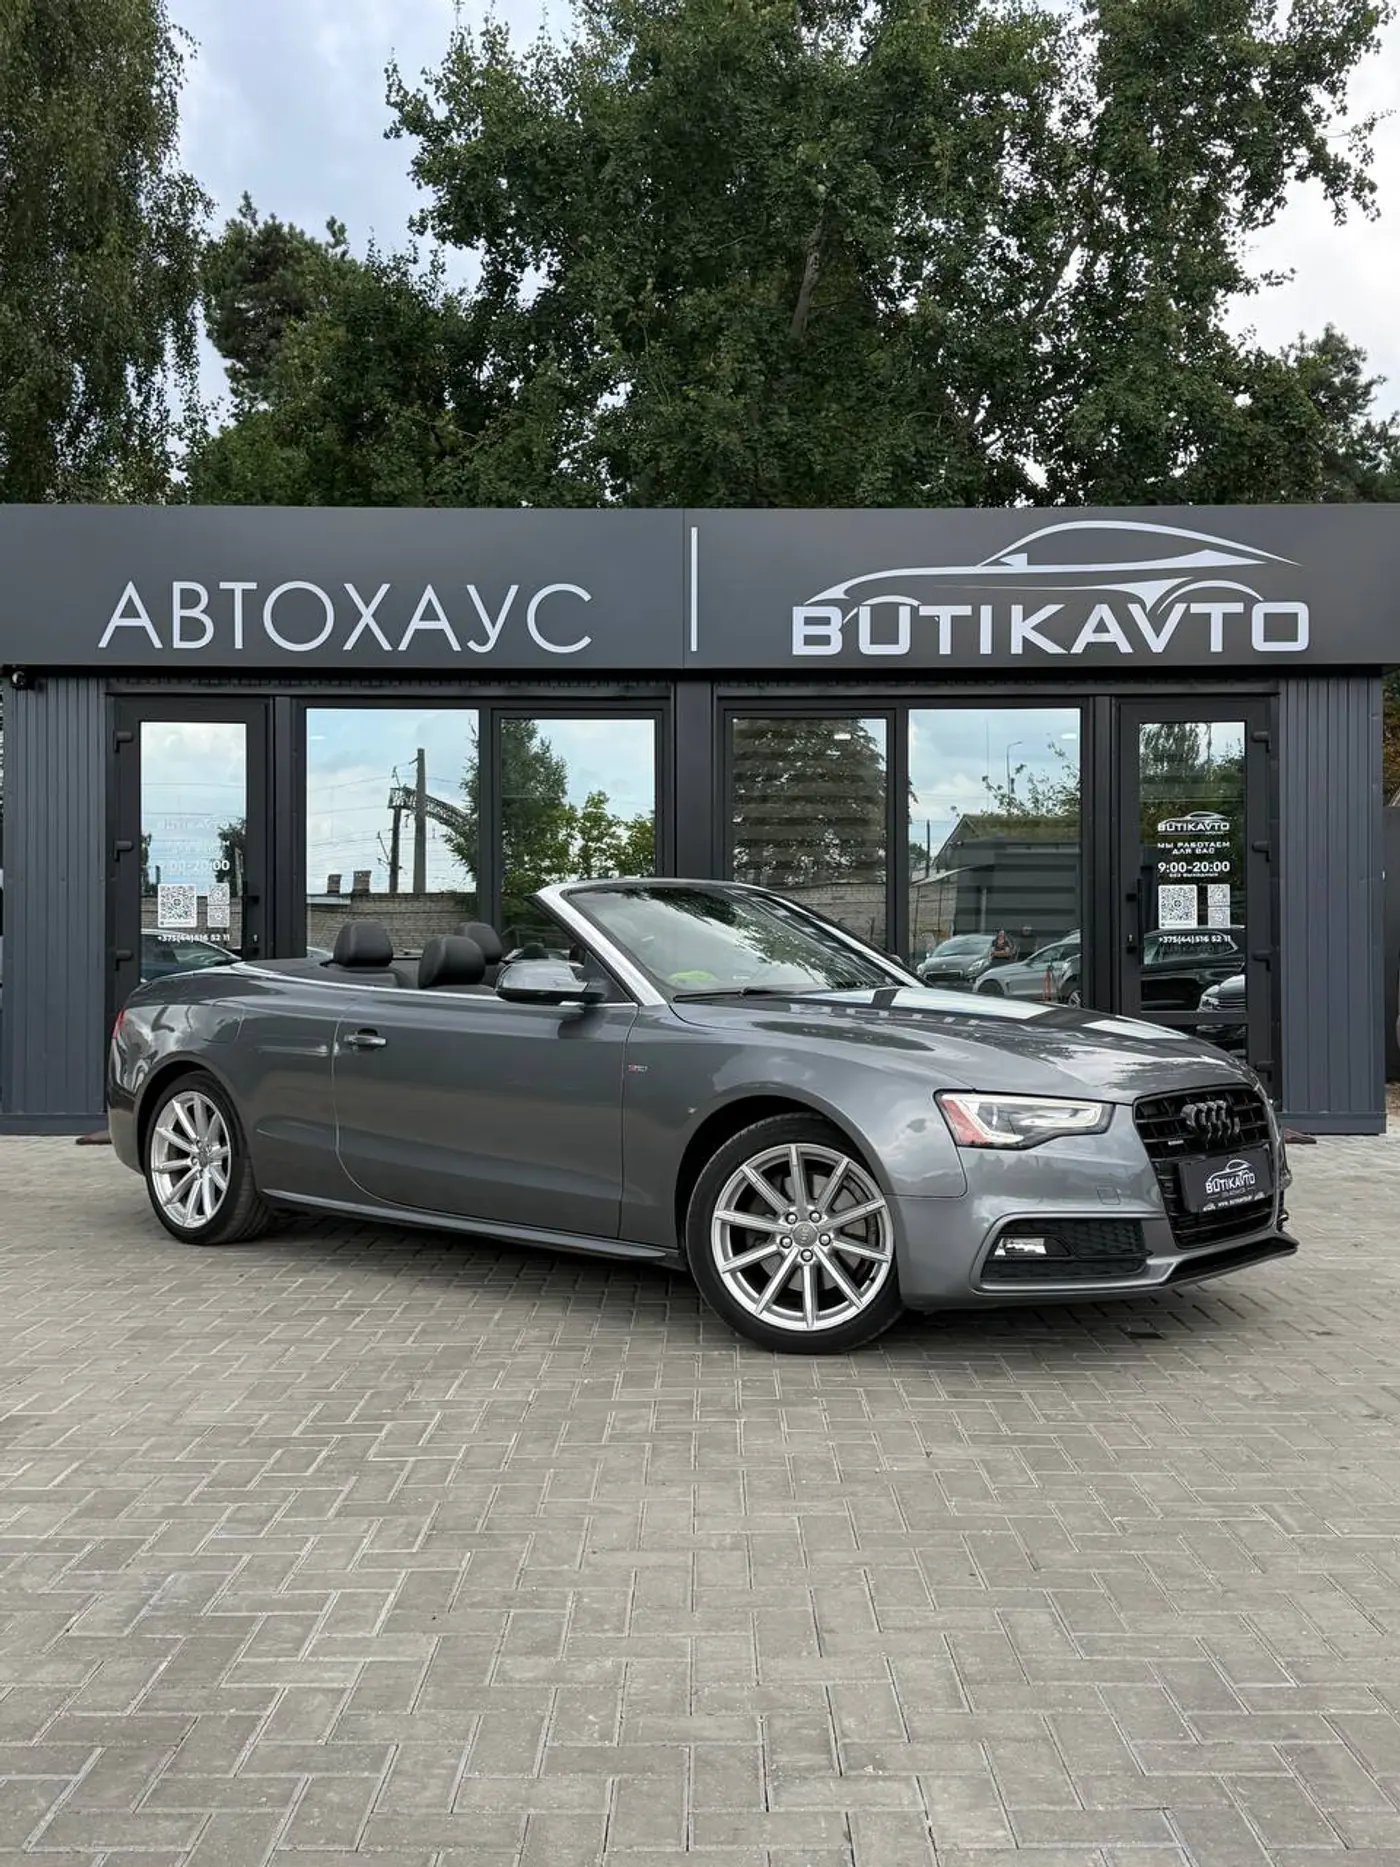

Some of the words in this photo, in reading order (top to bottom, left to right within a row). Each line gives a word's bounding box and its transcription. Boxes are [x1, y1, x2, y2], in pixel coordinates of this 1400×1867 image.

[98, 580, 593, 655] АВТОХАУС
[791, 601, 1310, 656] BUTIKAVTO
[1157, 821, 1230, 832] BUTIKAVTO
[1158, 861, 1231, 873] 9:00-20:00
[1205, 1172, 1256, 1194] BUTIKAVTO
